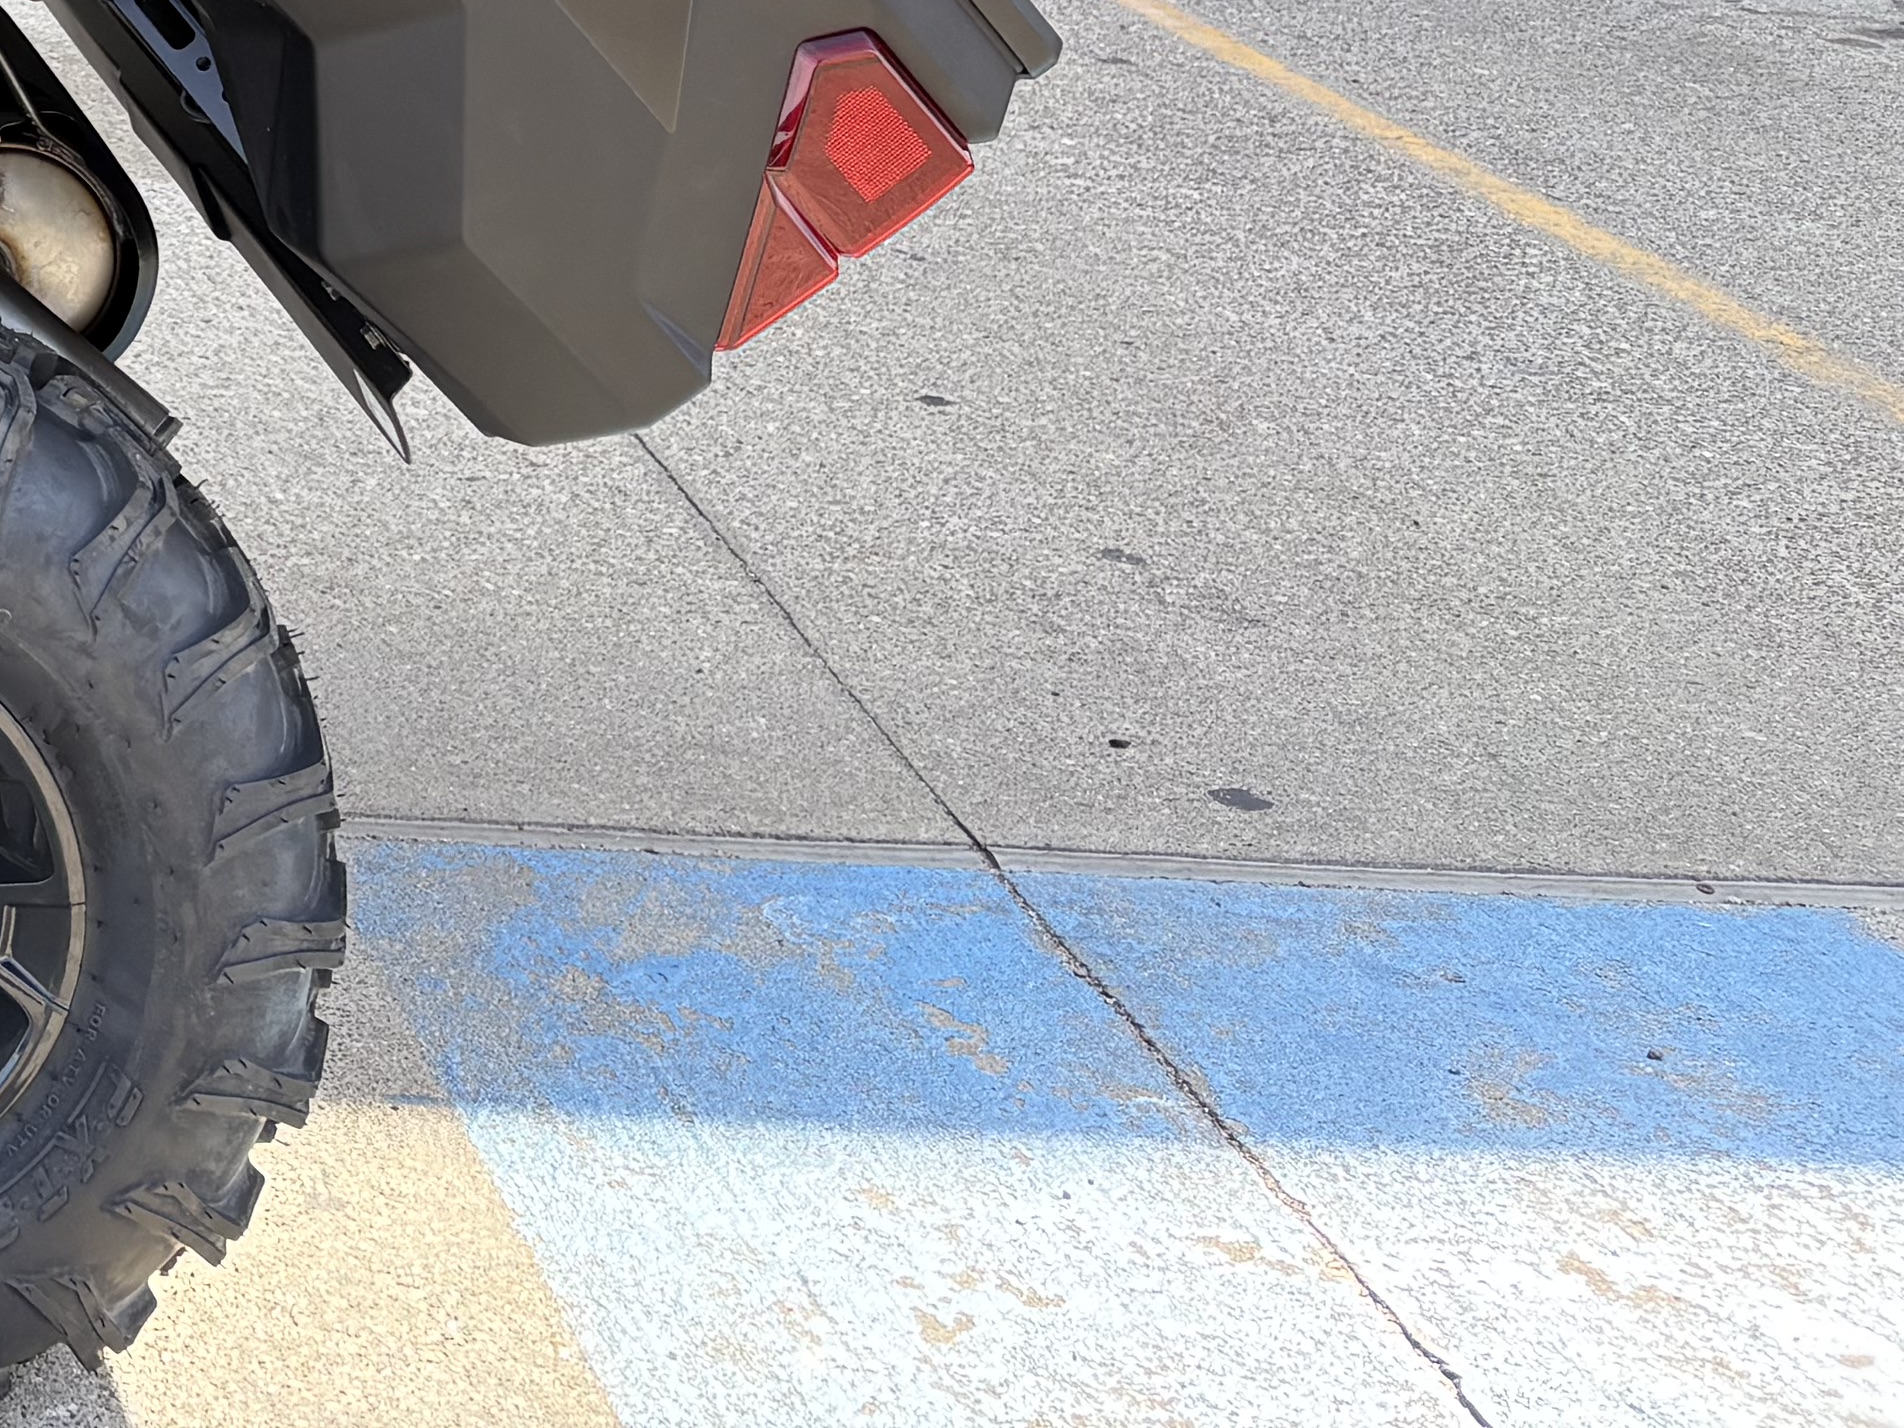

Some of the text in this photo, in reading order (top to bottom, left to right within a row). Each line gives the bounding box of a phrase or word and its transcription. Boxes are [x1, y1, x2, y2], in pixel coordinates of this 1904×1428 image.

[83, 1001, 107, 1041] FOR
[61, 1047, 87, 1088] ATV
[40, 1093, 61, 1121] OR
[6, 1124, 39, 1157] UTV
